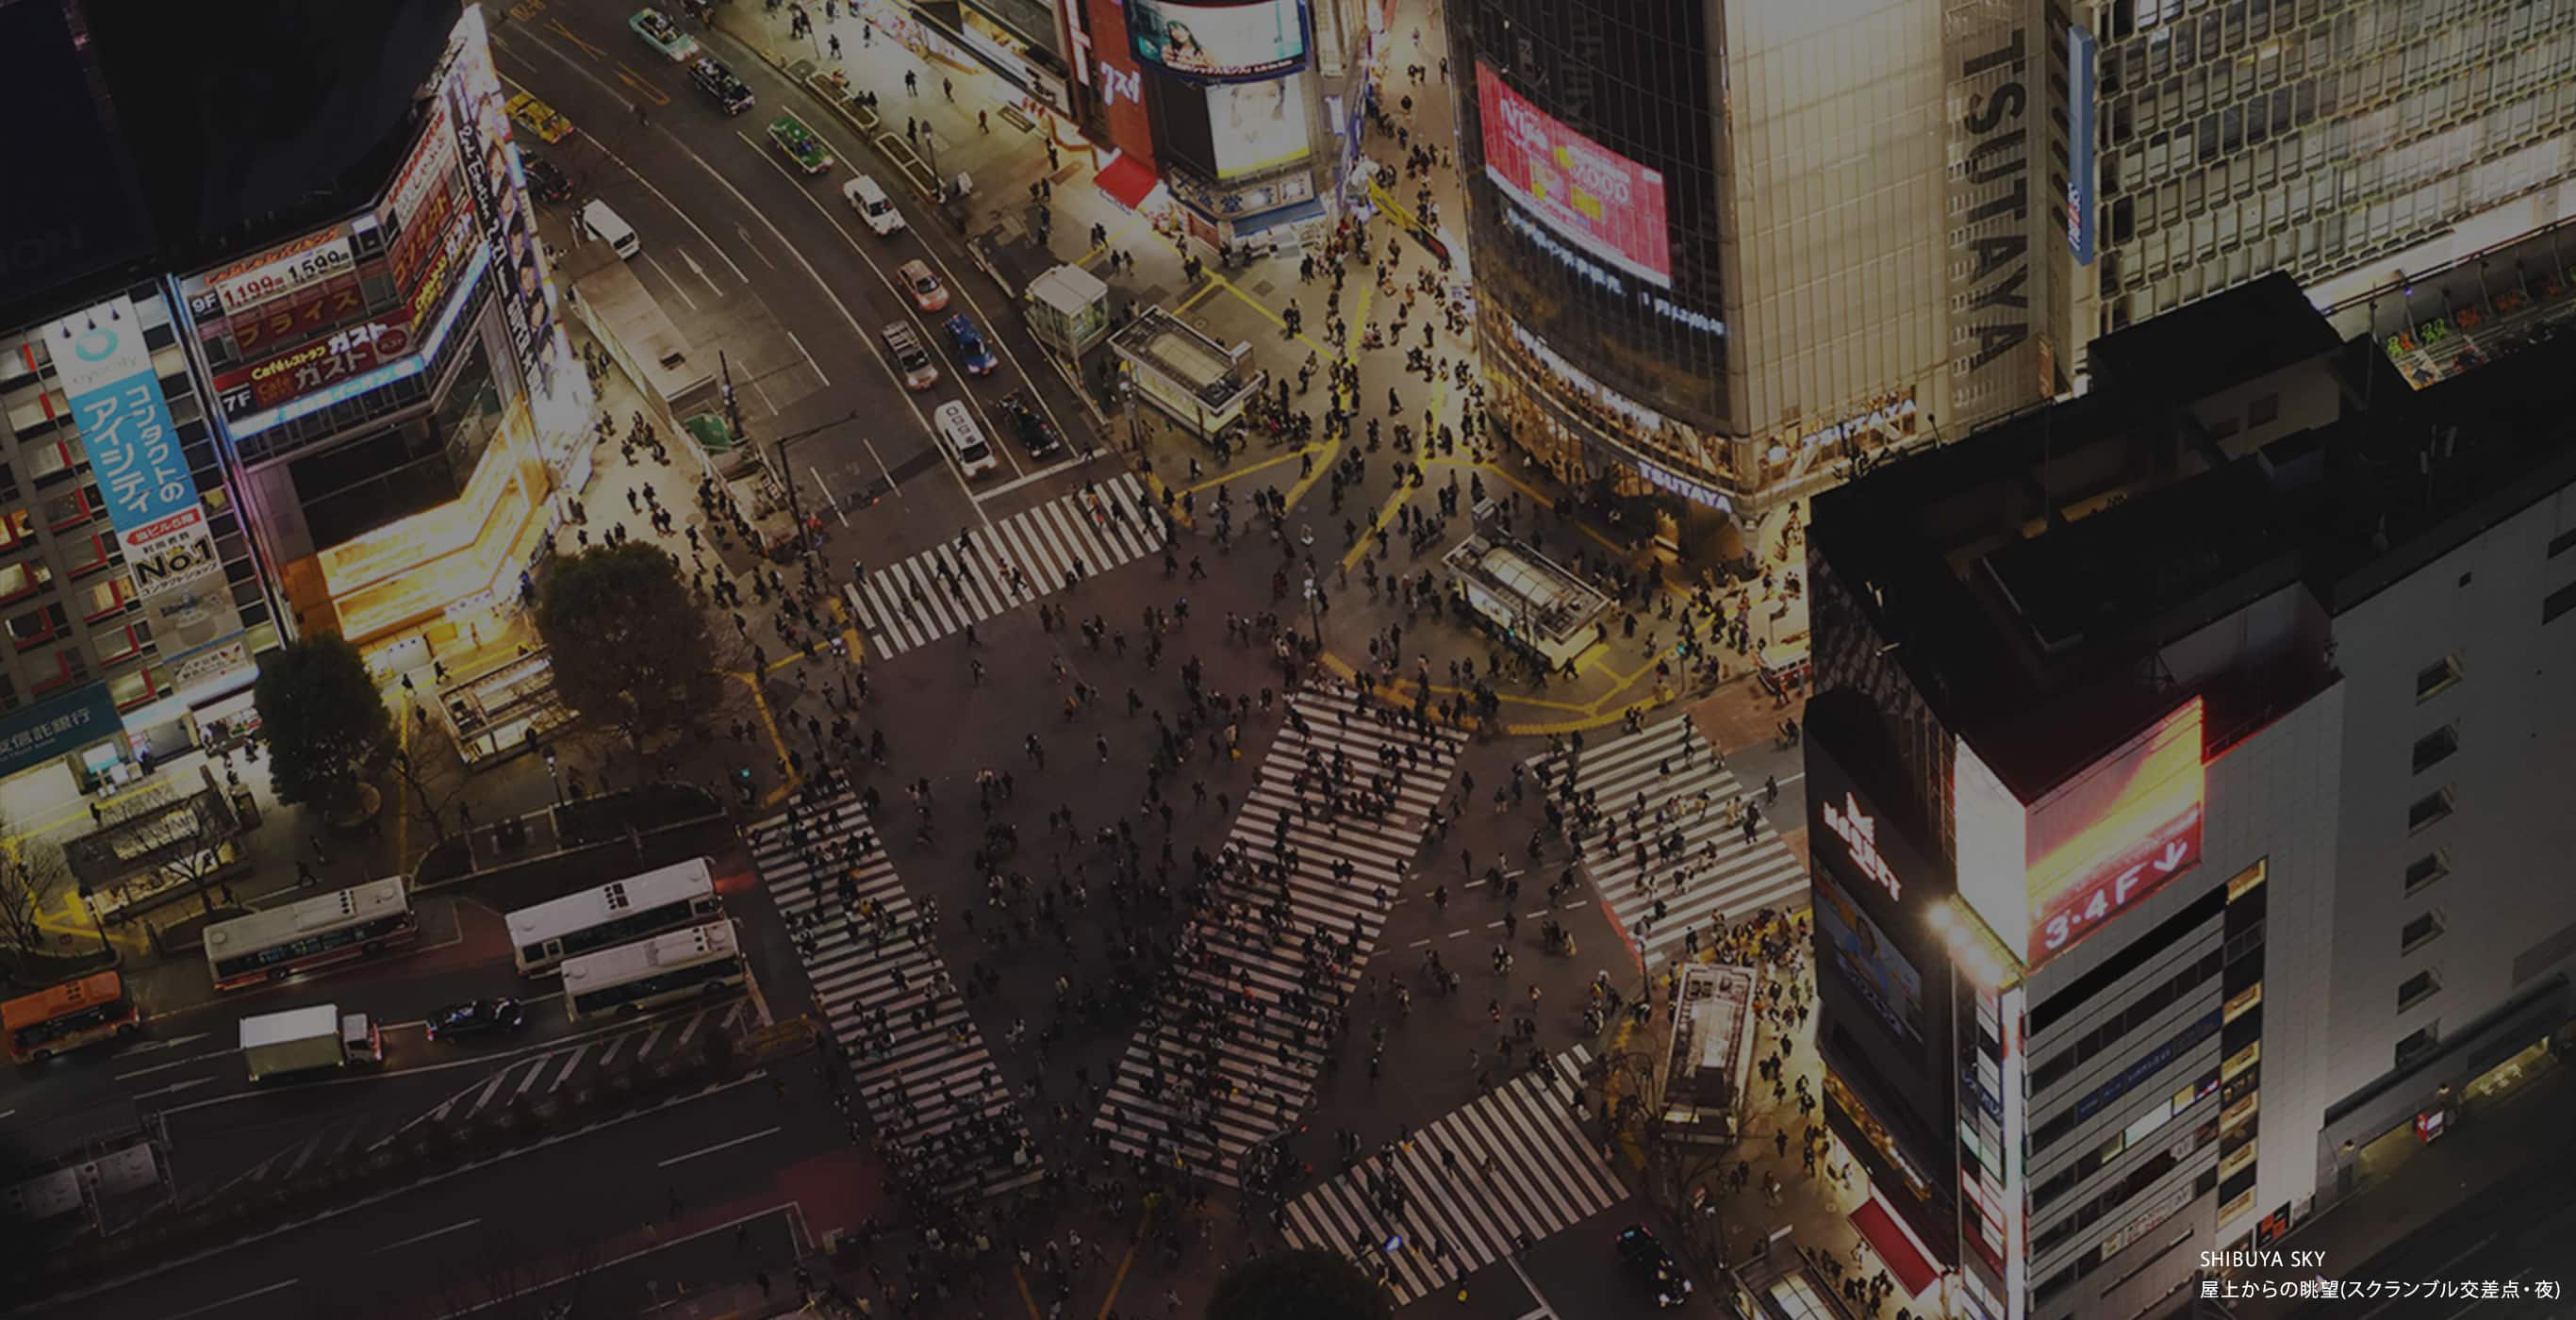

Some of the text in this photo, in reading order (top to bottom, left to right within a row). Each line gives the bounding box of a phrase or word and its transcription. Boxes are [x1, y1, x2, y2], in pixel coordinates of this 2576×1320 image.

[1963, 28, 2029, 372] TSUTAYA
[192, 293, 217, 313] 9F
[327, 322, 389, 355] ガスト
[296, 350, 369, 390] ガスト
[223, 391, 253, 412] 7F
[83, 398, 148, 514] アイシティ
[125, 384, 185, 503] コンタクトの
[1637, 461, 1732, 514] TSUTAYA
[137, 536, 213, 583] No.1
